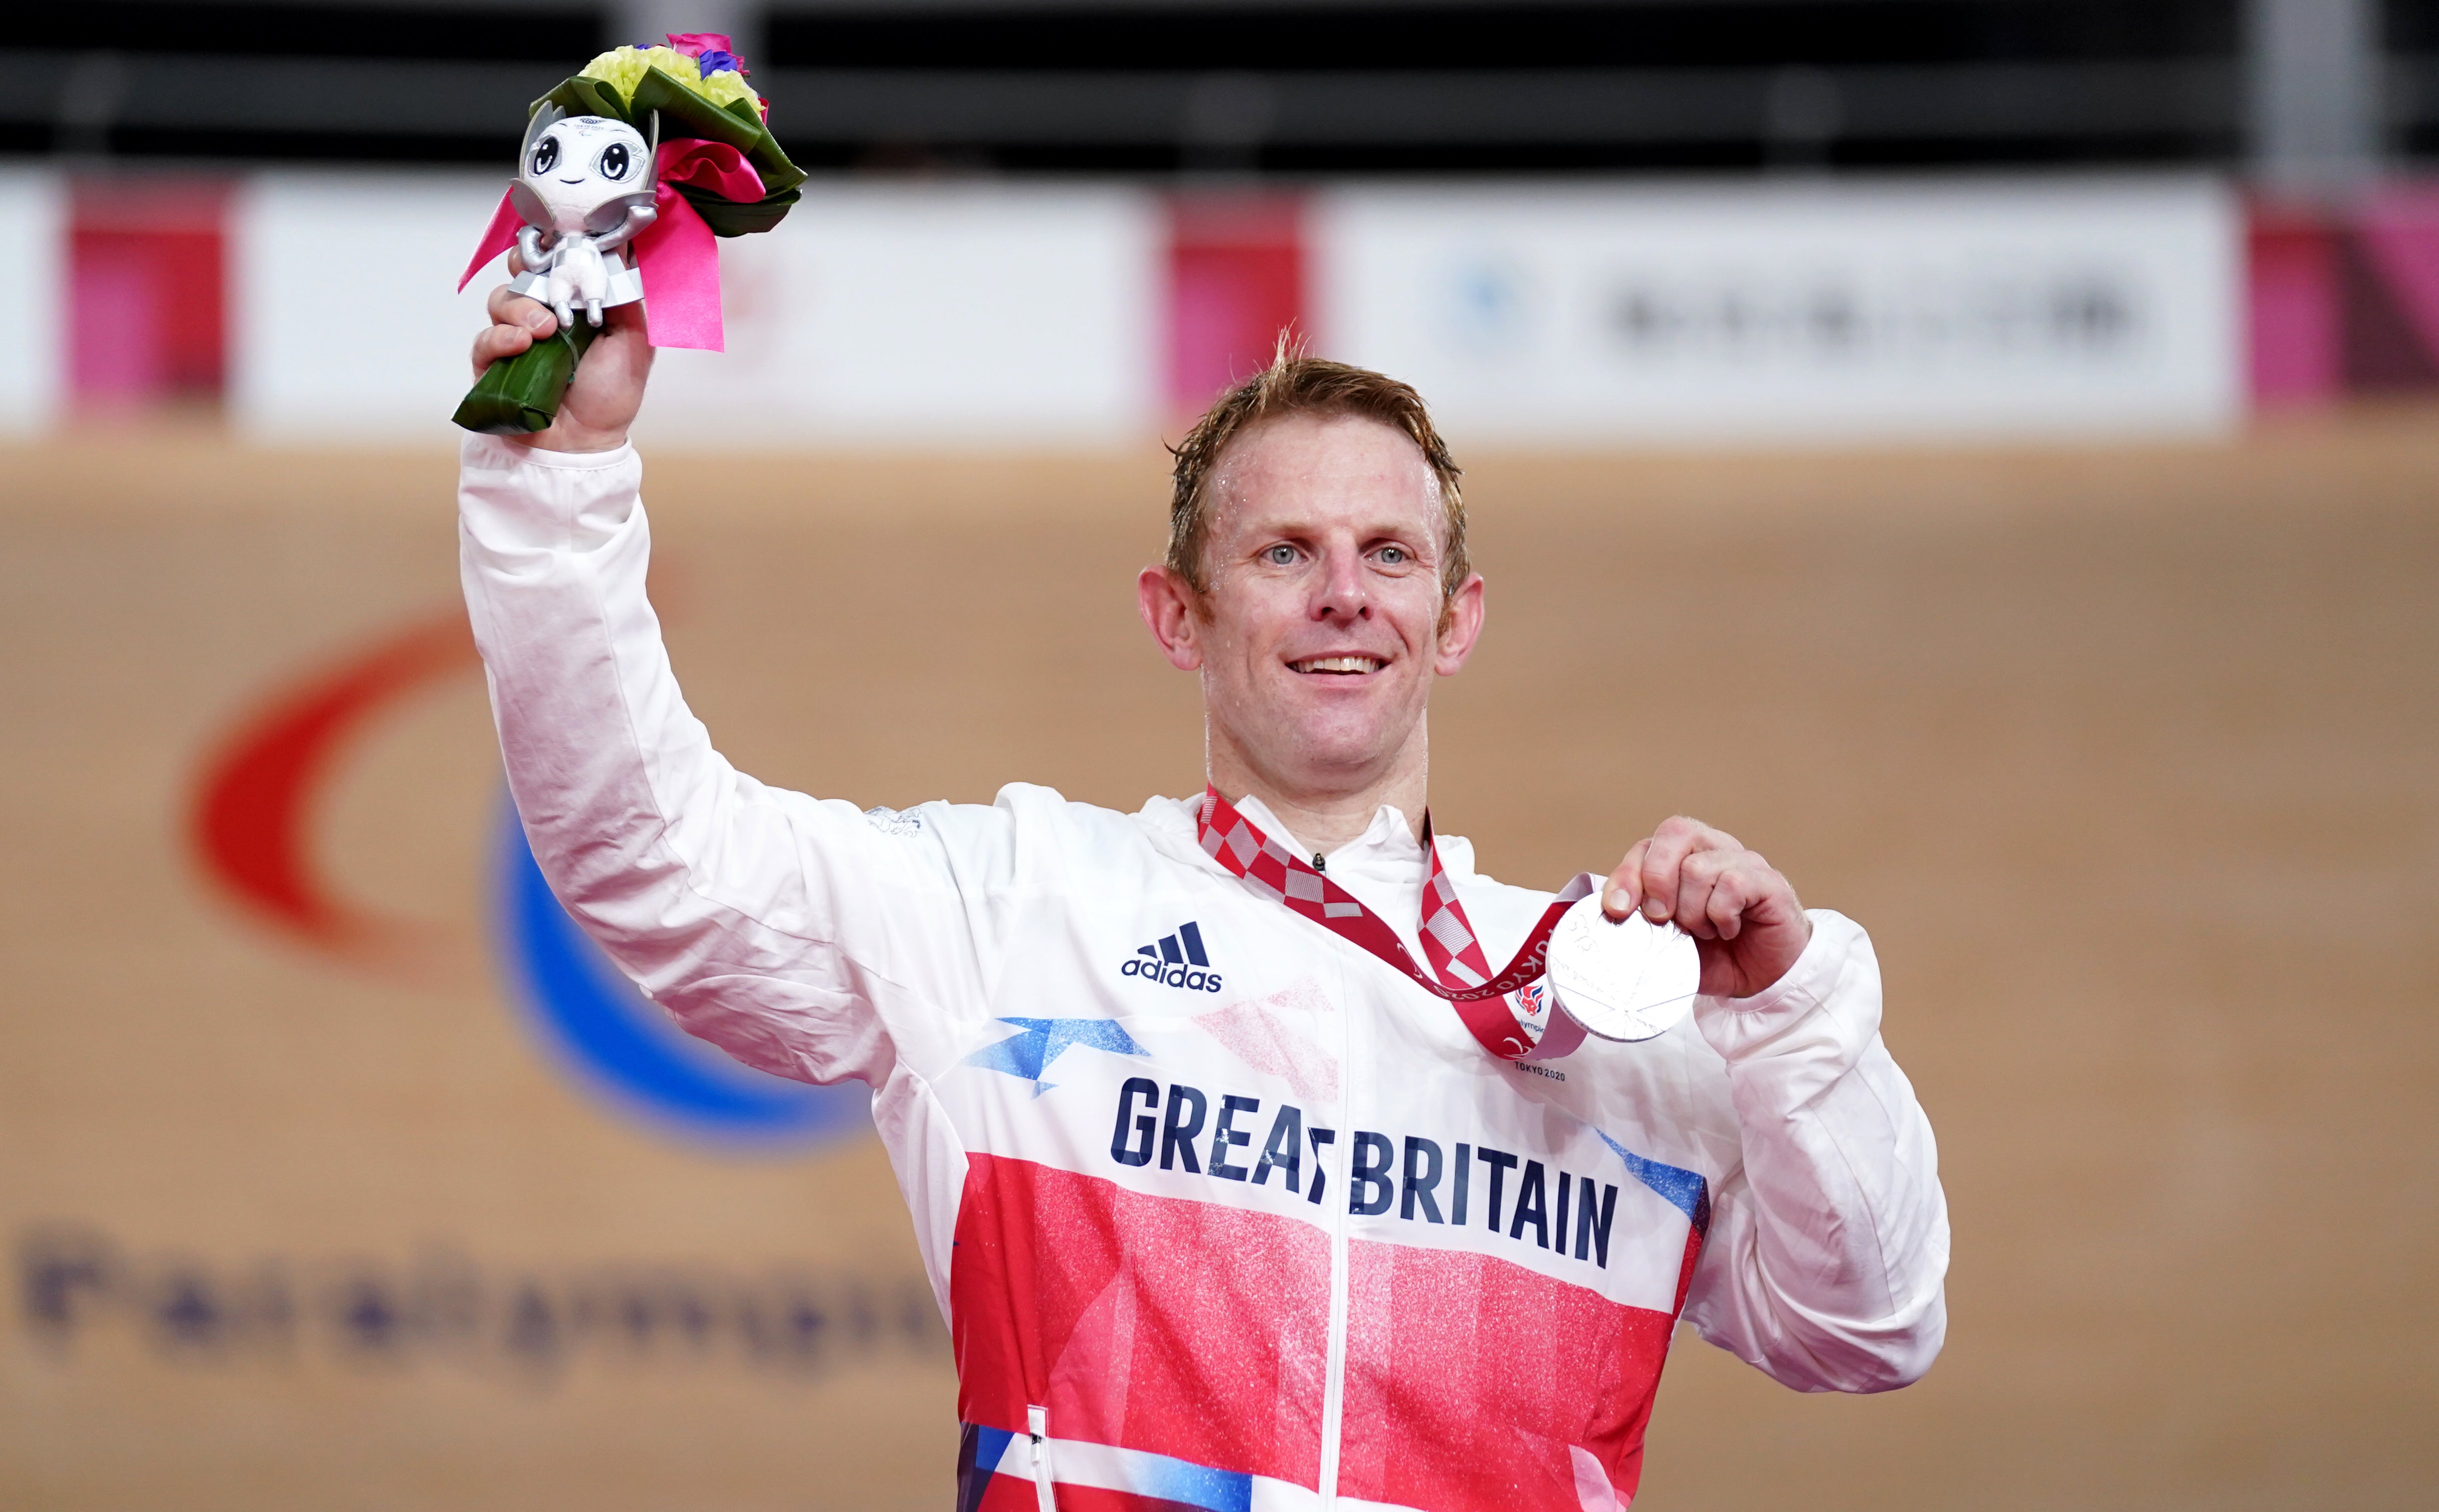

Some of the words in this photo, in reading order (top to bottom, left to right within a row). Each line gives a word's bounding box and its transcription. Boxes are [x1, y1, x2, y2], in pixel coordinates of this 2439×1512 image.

[1121, 959, 1222, 993] adidas
[1514, 1061, 1543, 1075] TOKYO
[1545, 1069, 1565, 1081] 2020
[1110, 1077, 1336, 1205] GREAT
[1349, 1131, 1619, 1269] BRITAIN
